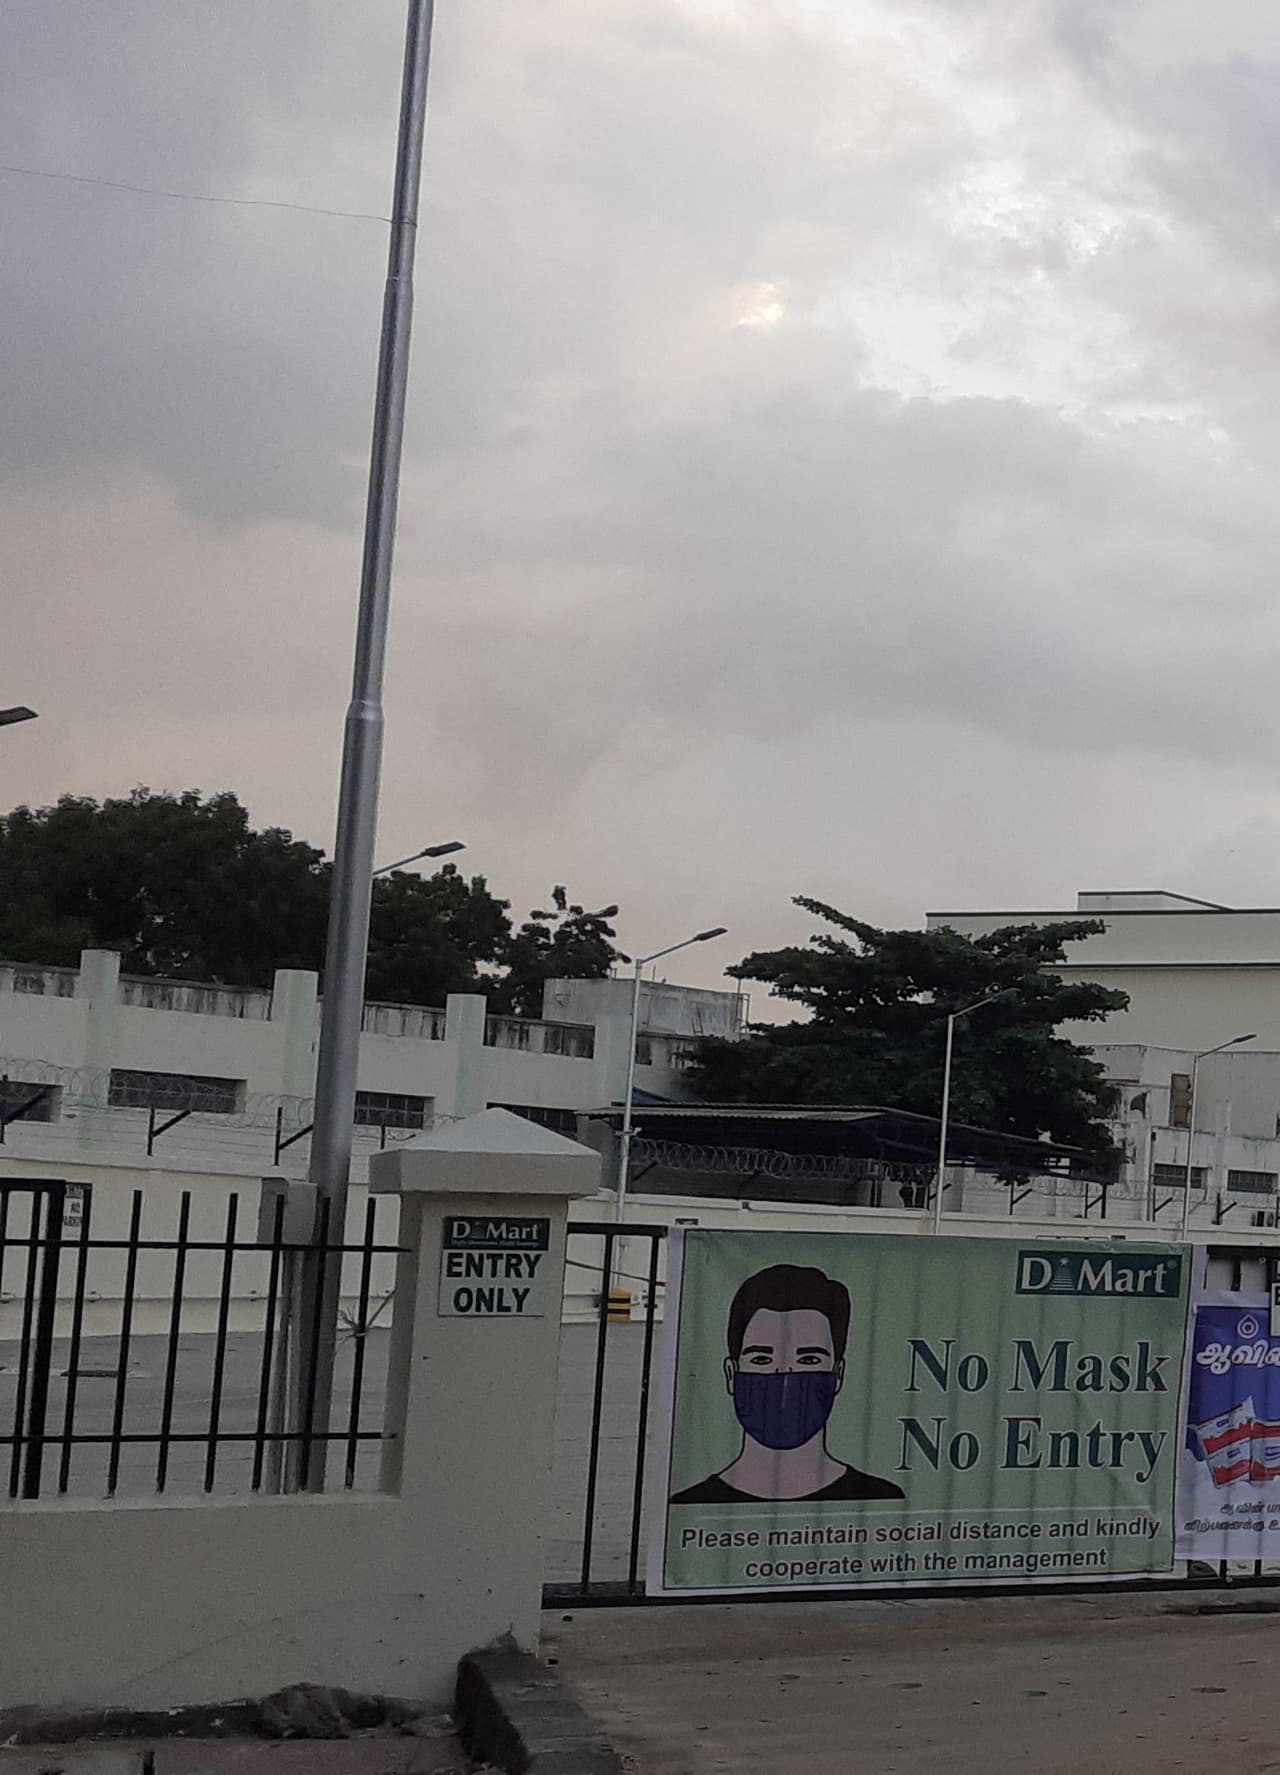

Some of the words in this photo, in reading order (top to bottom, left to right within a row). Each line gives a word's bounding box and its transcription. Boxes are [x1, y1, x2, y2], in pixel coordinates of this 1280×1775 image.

[447, 1252, 542, 1279] ENTRY
[453, 1287, 531, 1313] ONLY
[906, 1338, 990, 1394] No
[1008, 1339, 1169, 1394] Mask
[896, 1416, 981, 1472] No
[1001, 1416, 1169, 1482] Entry
[681, 1527, 760, 1549] Please
[767, 1525, 869, 1547] maintain
[875, 1520, 943, 1544] social
[949, 1521, 1045, 1541] distance
[1049, 1519, 1091, 1539] and
[1096, 1516, 1161, 1542] kindly
[745, 1558, 864, 1580] cooperate
[870, 1555, 918, 1574] with
[923, 1553, 958, 1573] the
[964, 1548, 1107, 1572] management
